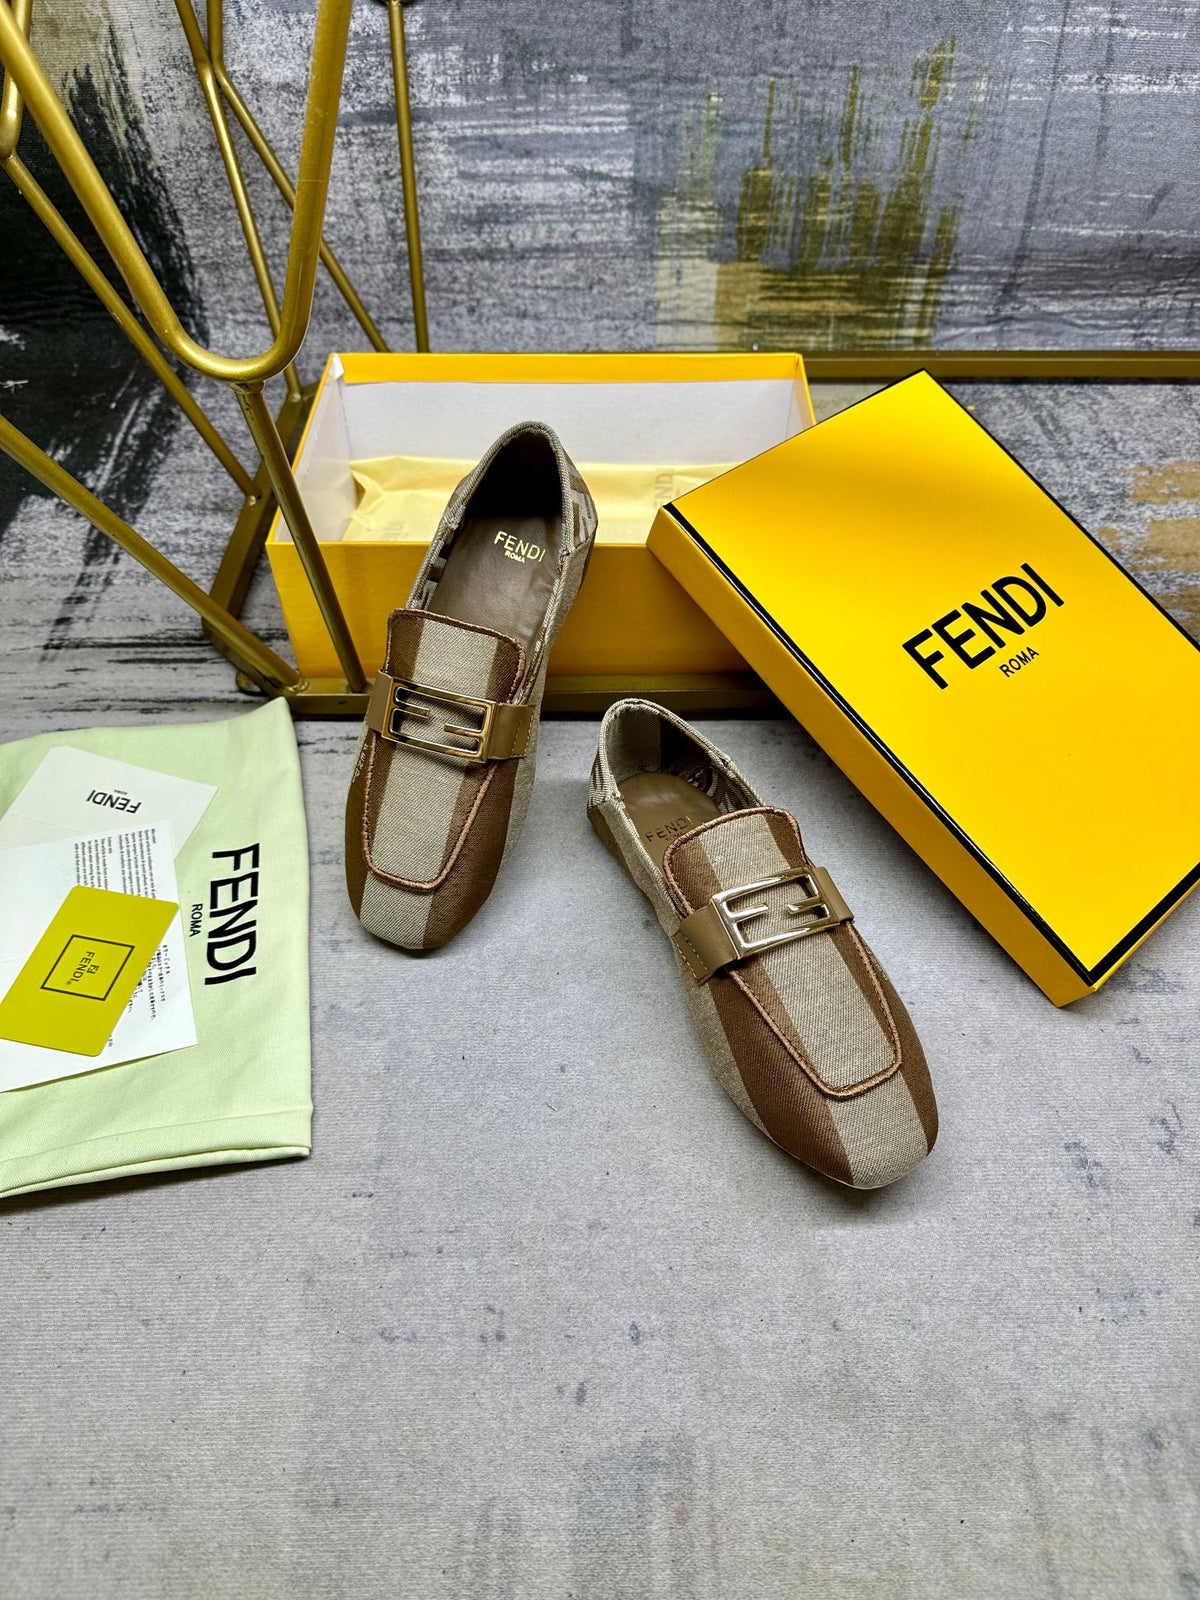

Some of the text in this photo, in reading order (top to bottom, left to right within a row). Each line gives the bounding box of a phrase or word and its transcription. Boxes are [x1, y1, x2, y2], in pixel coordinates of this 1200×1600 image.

[494, 530, 546, 562] FENDI
[504, 550, 525, 563] ROMA
[902, 563, 1064, 690] FENDI
[999, 647, 1040, 678] ROMA
[86, 789, 142, 814] FENDI
[645, 816, 694, 842] FENDI
[189, 903, 203, 938] ROMA
[204, 843, 260, 985] FENDI
